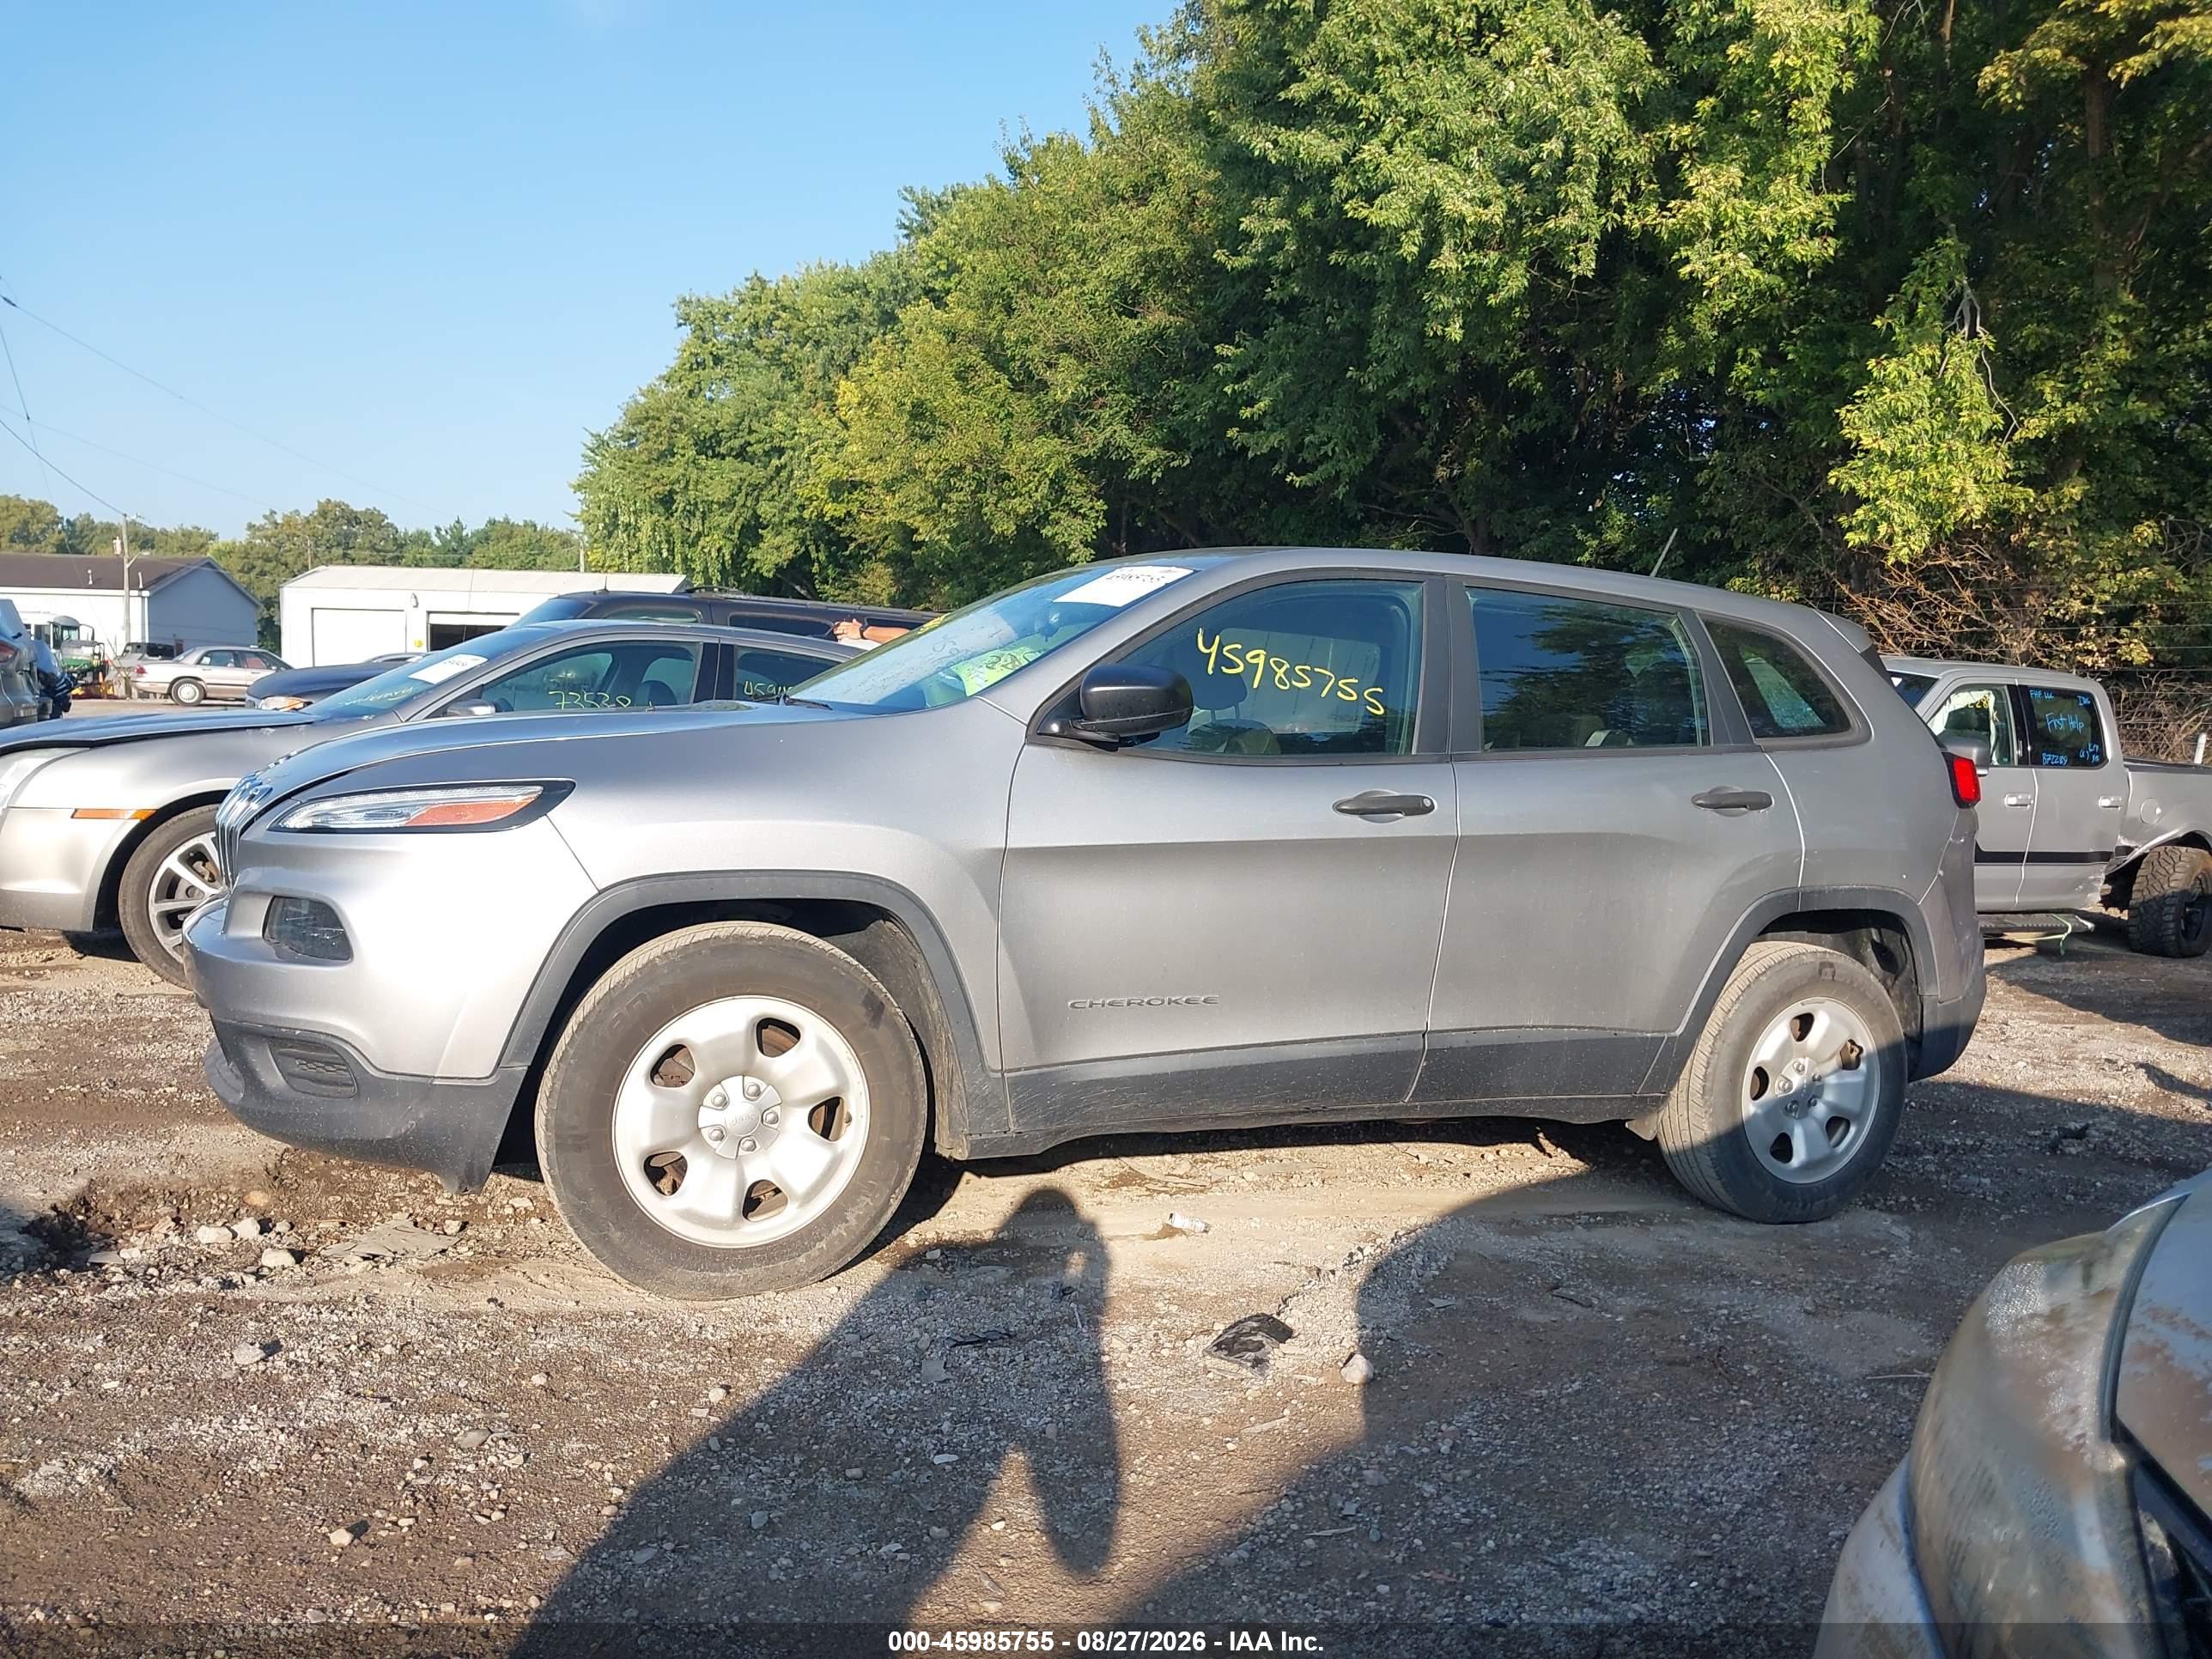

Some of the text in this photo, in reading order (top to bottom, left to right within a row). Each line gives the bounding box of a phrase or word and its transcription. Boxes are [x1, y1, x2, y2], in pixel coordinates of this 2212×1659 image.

[1197, 627, 1385, 715] 45985755
[2068, 714, 2084, 734] Help
[1068, 995, 1219, 1009] CHEROKEE
